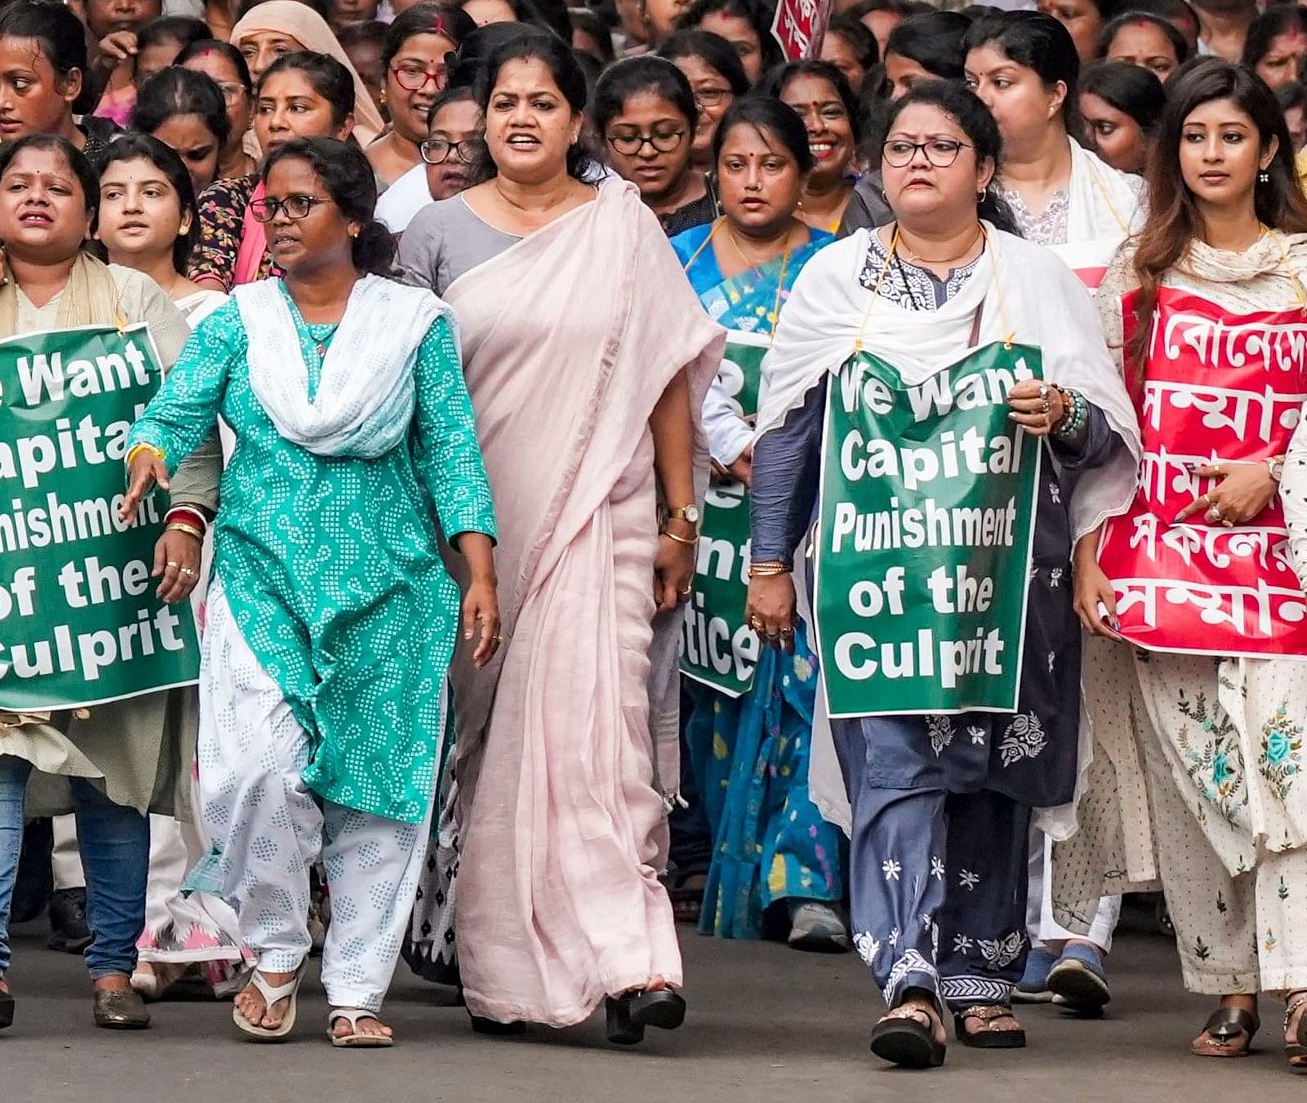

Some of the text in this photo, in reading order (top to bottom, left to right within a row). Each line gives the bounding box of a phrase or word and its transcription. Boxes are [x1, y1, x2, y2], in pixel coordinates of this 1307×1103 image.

[16, 340, 151, 406] Want
[907, 357, 1034, 423] Want
[840, 425, 1024, 491] Capital
[831, 496, 1016, 553] Punishment
[58, 556, 150, 609] the
[848, 565, 994, 617] of the
[683, 592, 760, 683] tice
[834, 627, 1005, 689] Culprit
